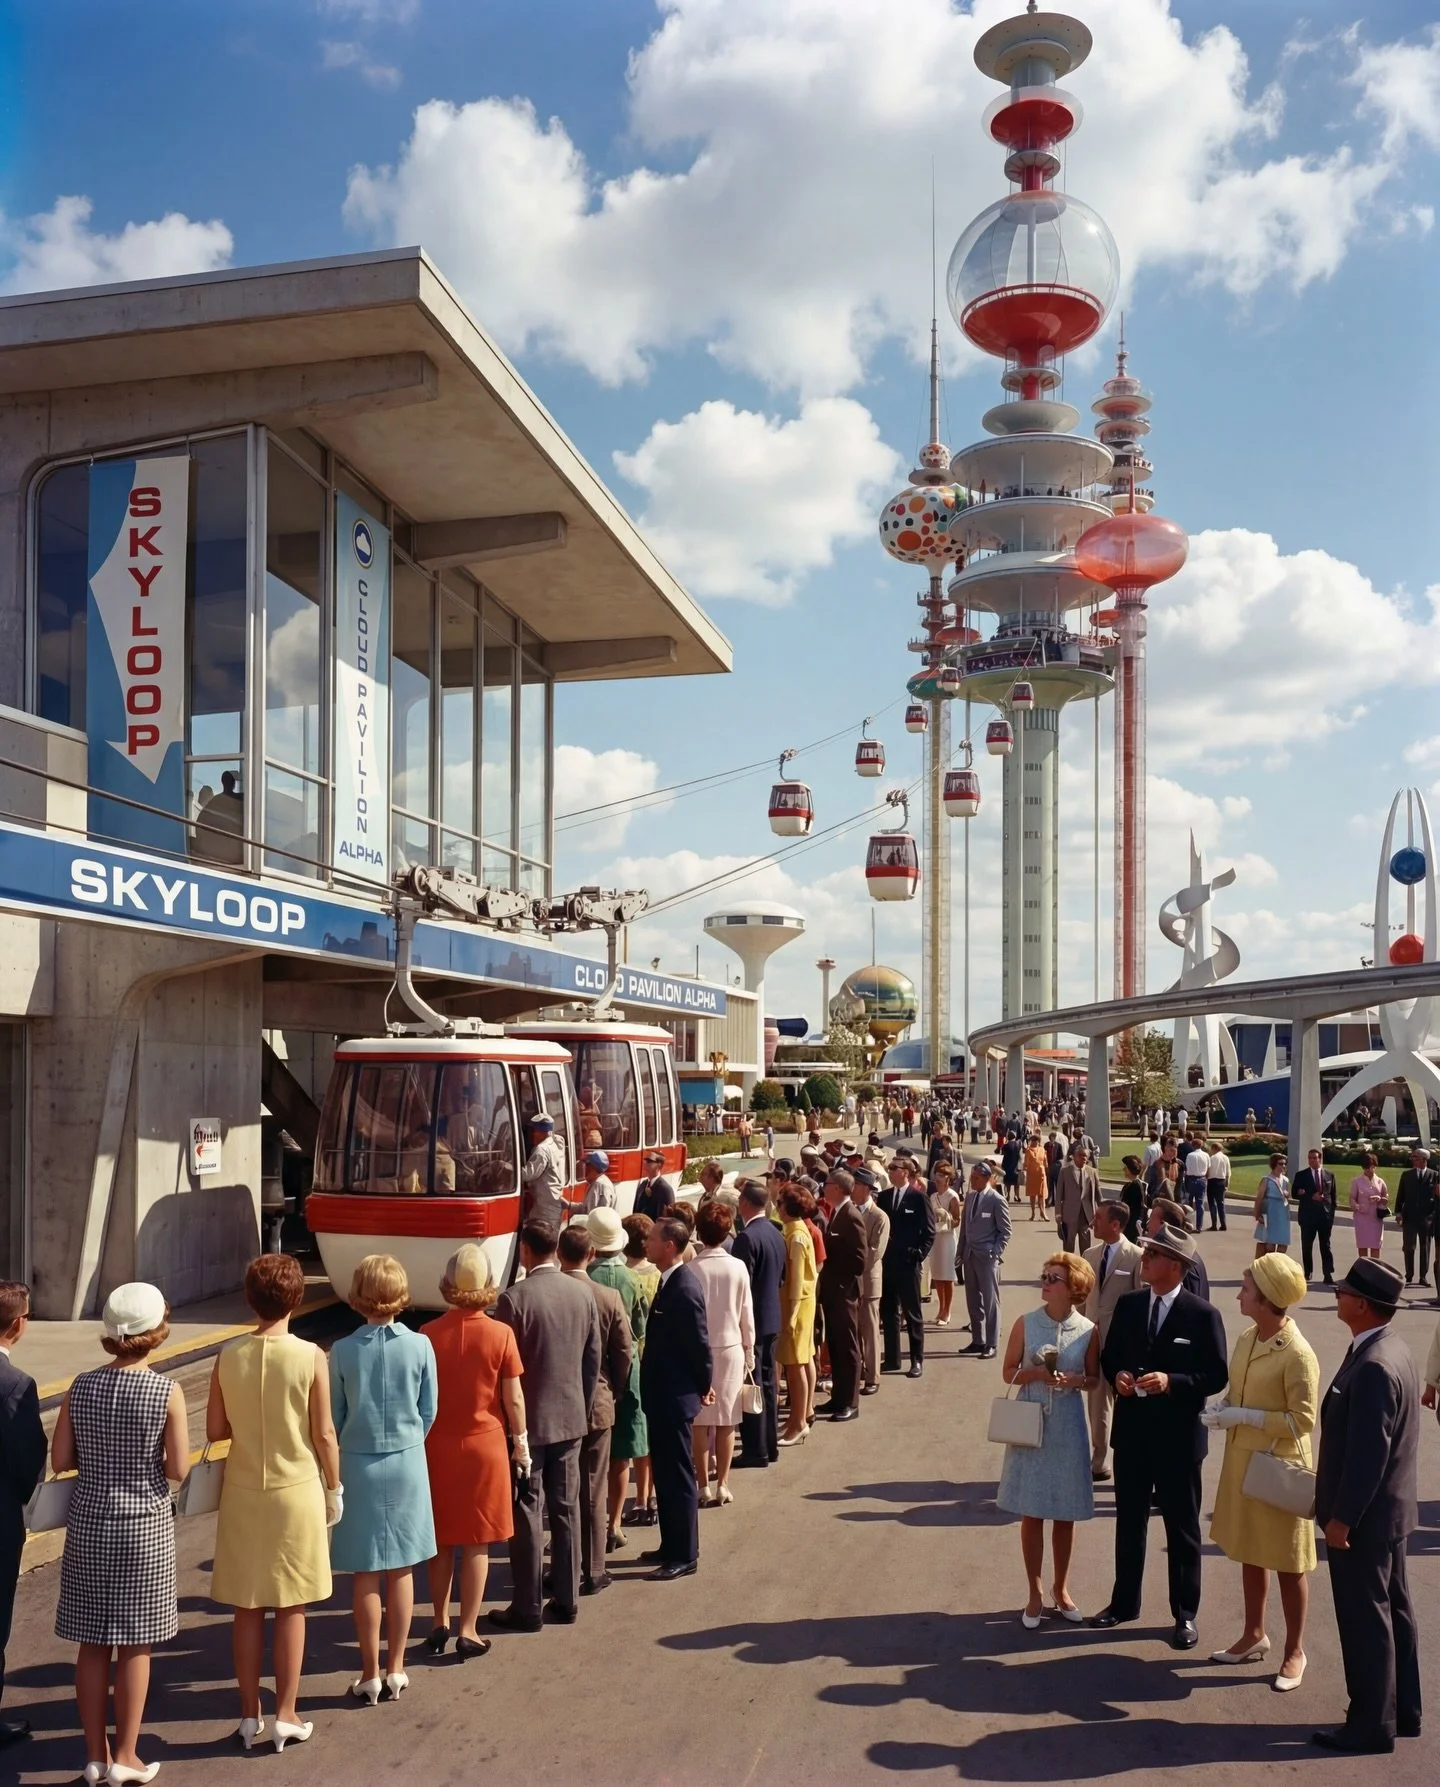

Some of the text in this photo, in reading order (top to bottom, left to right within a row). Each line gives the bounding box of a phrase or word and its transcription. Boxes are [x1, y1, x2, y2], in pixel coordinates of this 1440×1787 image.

[127, 486, 163, 756] SKYLOOP
[357, 580, 368, 834] CLOUD PAVILION
[339, 841, 383, 866] ALPHA
[70, 859, 305, 935] SKYLOOP
[575, 965, 716, 1009] CLOD PAVILION ALPHA
